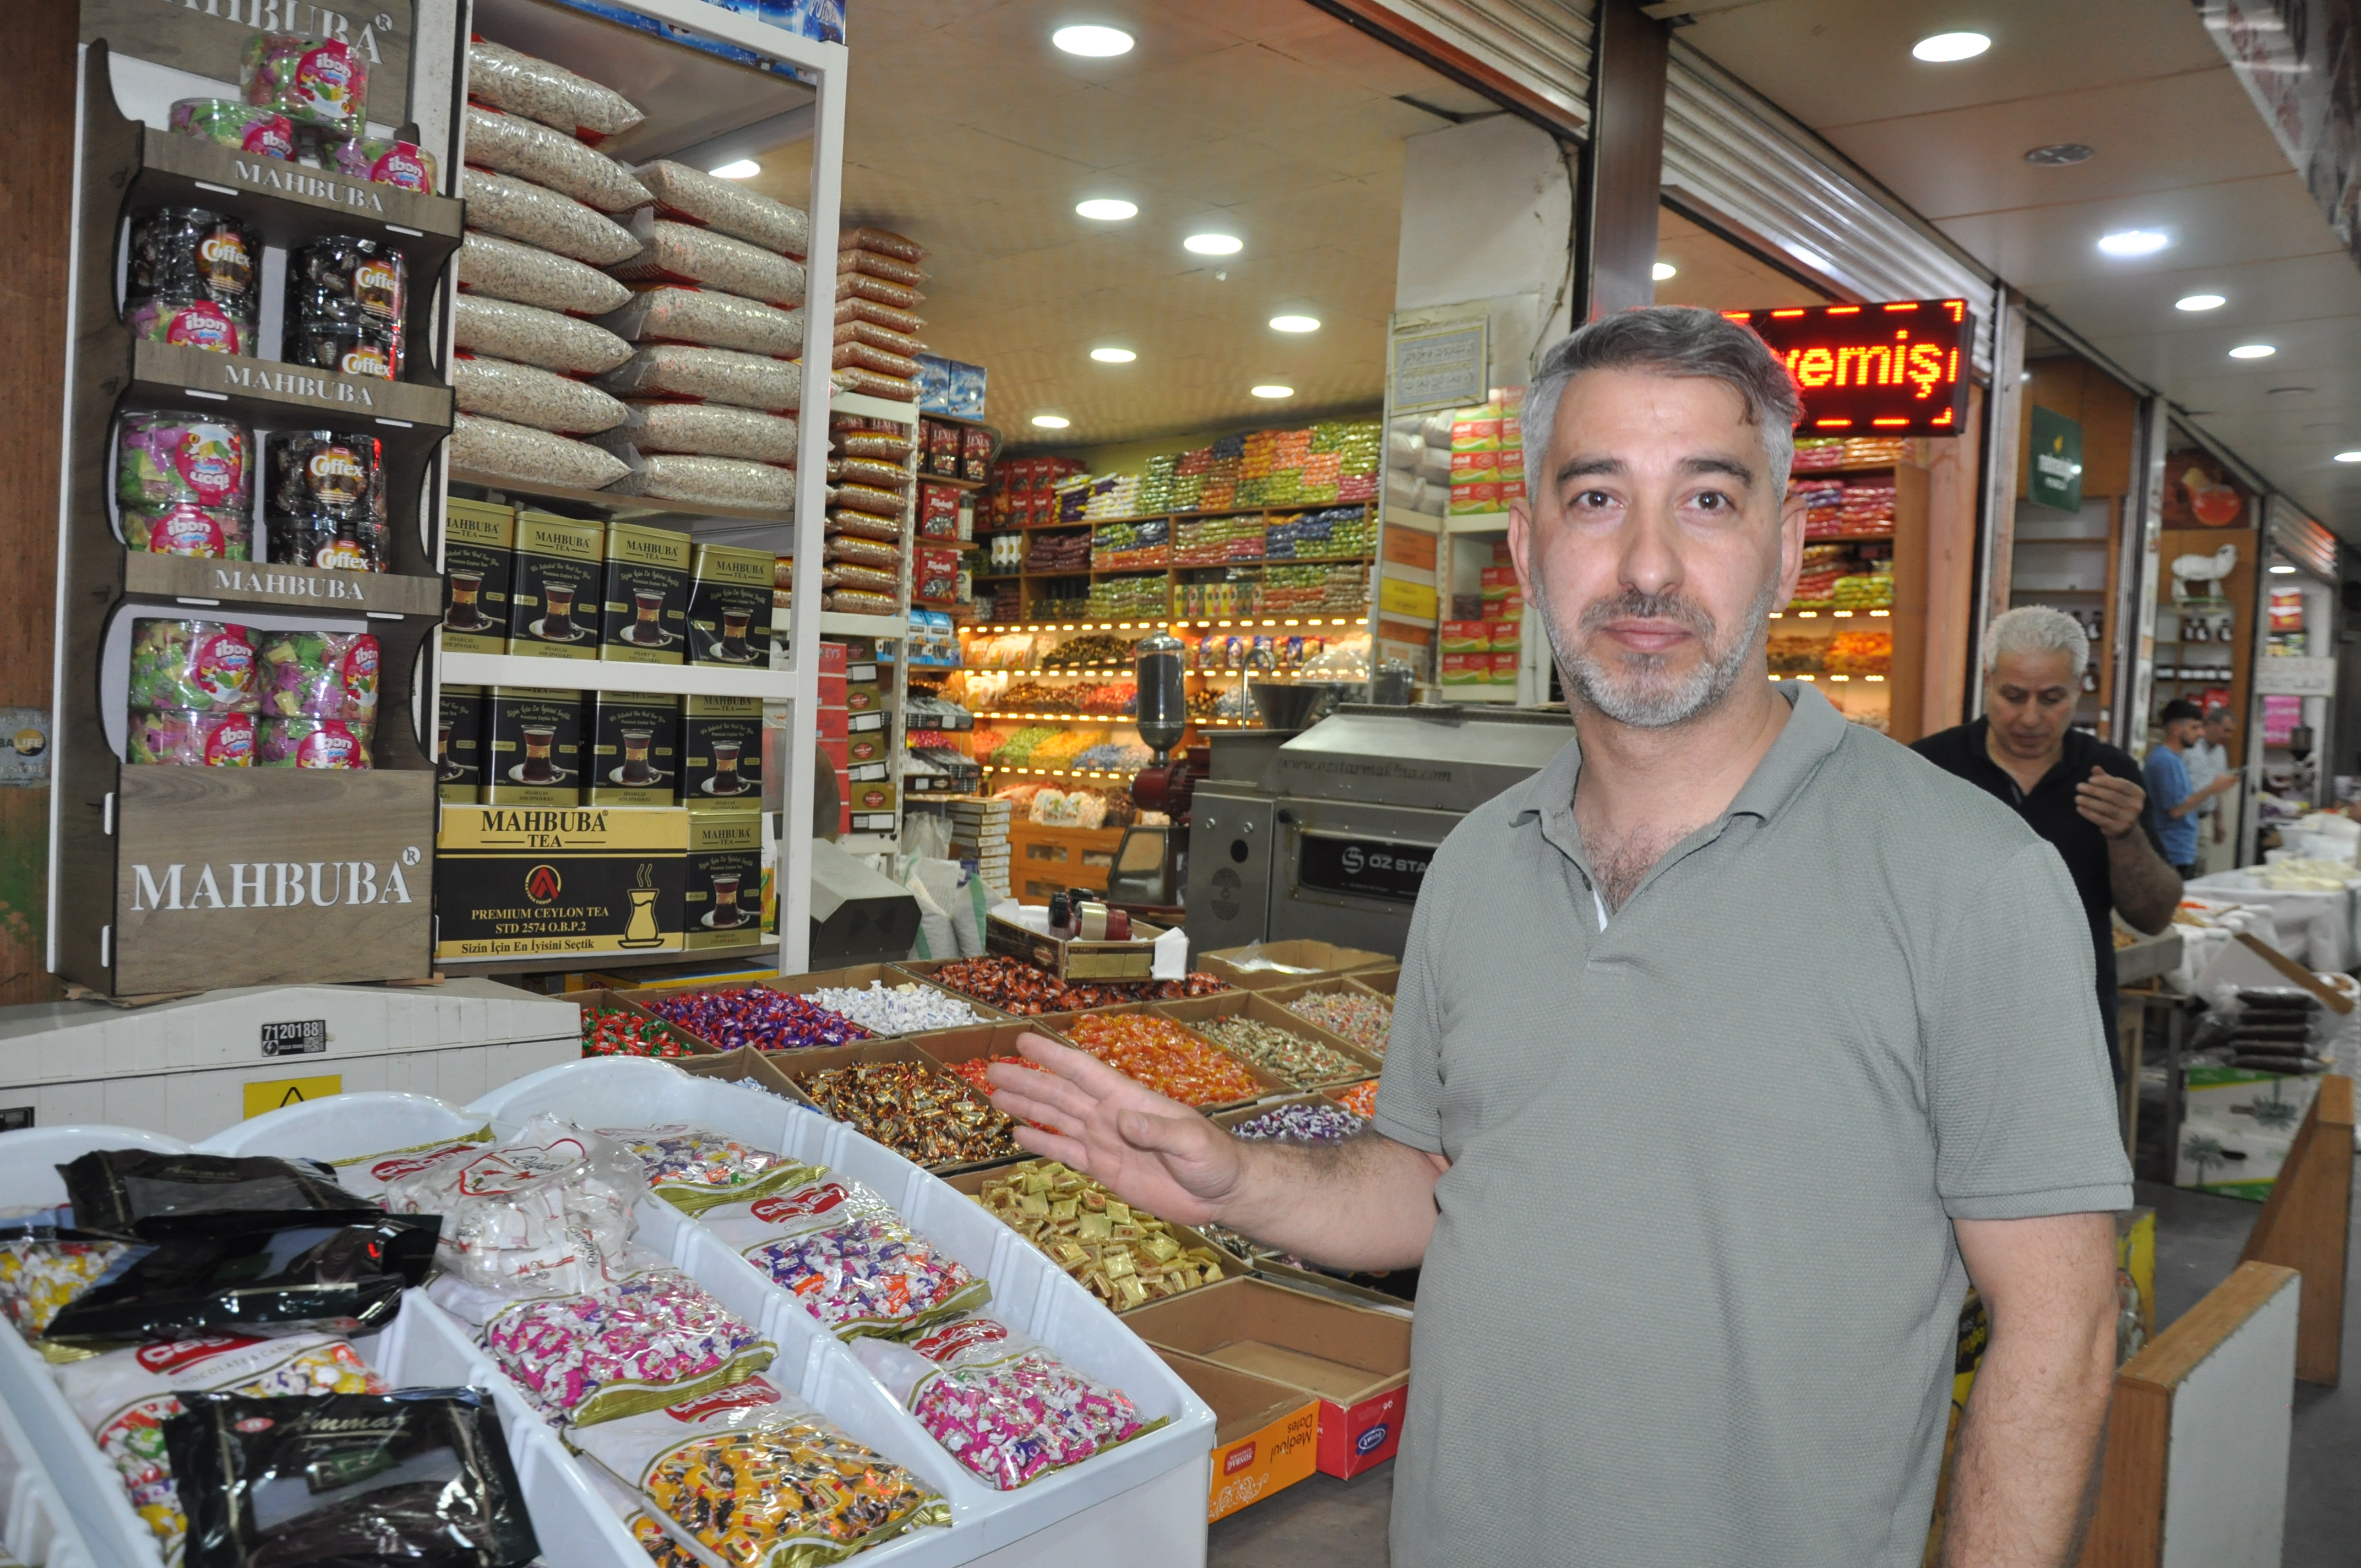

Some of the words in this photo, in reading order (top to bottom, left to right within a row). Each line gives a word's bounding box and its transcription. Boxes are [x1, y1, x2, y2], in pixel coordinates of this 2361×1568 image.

[316, 53, 352, 79] ibon
[263, 130, 292, 155] ibon
[389, 156, 422, 177] ibon
[236, 160, 384, 212] MAHBUBA
[202, 239, 250, 268] Coffex
[186, 312, 227, 333] ibon
[342, 353, 391, 377] Coffex
[224, 364, 374, 406] MAHBUBA
[310, 455, 364, 477] Coffex
[189, 471, 230, 491] ibon
[167, 517, 211, 536] ibon
[461, 530, 477, 538] TEA
[535, 531, 590, 548] MAHBUBA
[555, 543, 570, 552] TEA
[627, 540, 678, 557] MAHBUBA
[317, 548, 369, 570] Coffex
[645, 552, 659, 560] TEA
[716, 560, 764, 575] MAHBUBA
[215, 569, 365, 600] MAHBUBA
[215, 639, 252, 657] ibon
[355, 647, 378, 665] ibon
[704, 696, 752, 705] MAHBUBA
[220, 727, 252, 745] ibon
[481, 810, 607, 832] MAHBUBA
[527, 835, 562, 847] TEA
[703, 829, 750, 839] MAHBUBA
[1395, 859, 1427, 873] STA
[130, 861, 412, 911] MAHBUBA
[471, 908, 531, 921] PREMIUM
[534, 907, 584, 918] CEYLON
[586, 906, 609, 917] TEA
[495, 923, 520, 934] STD
[521, 922, 546, 933] 2574
[548, 921, 587, 933] O.B.P.2
[461, 943, 488, 954] Sizin
[490, 940, 511, 953] İçin
[513, 941, 528, 952] En
[530, 939, 562, 954] İyisini
[564, 938, 595, 951] Seçtik
[264, 1021, 319, 1041] 7120188
[1287, 1413, 1313, 1434] Dates
[1270, 1429, 1312, 1464] Medjoul
